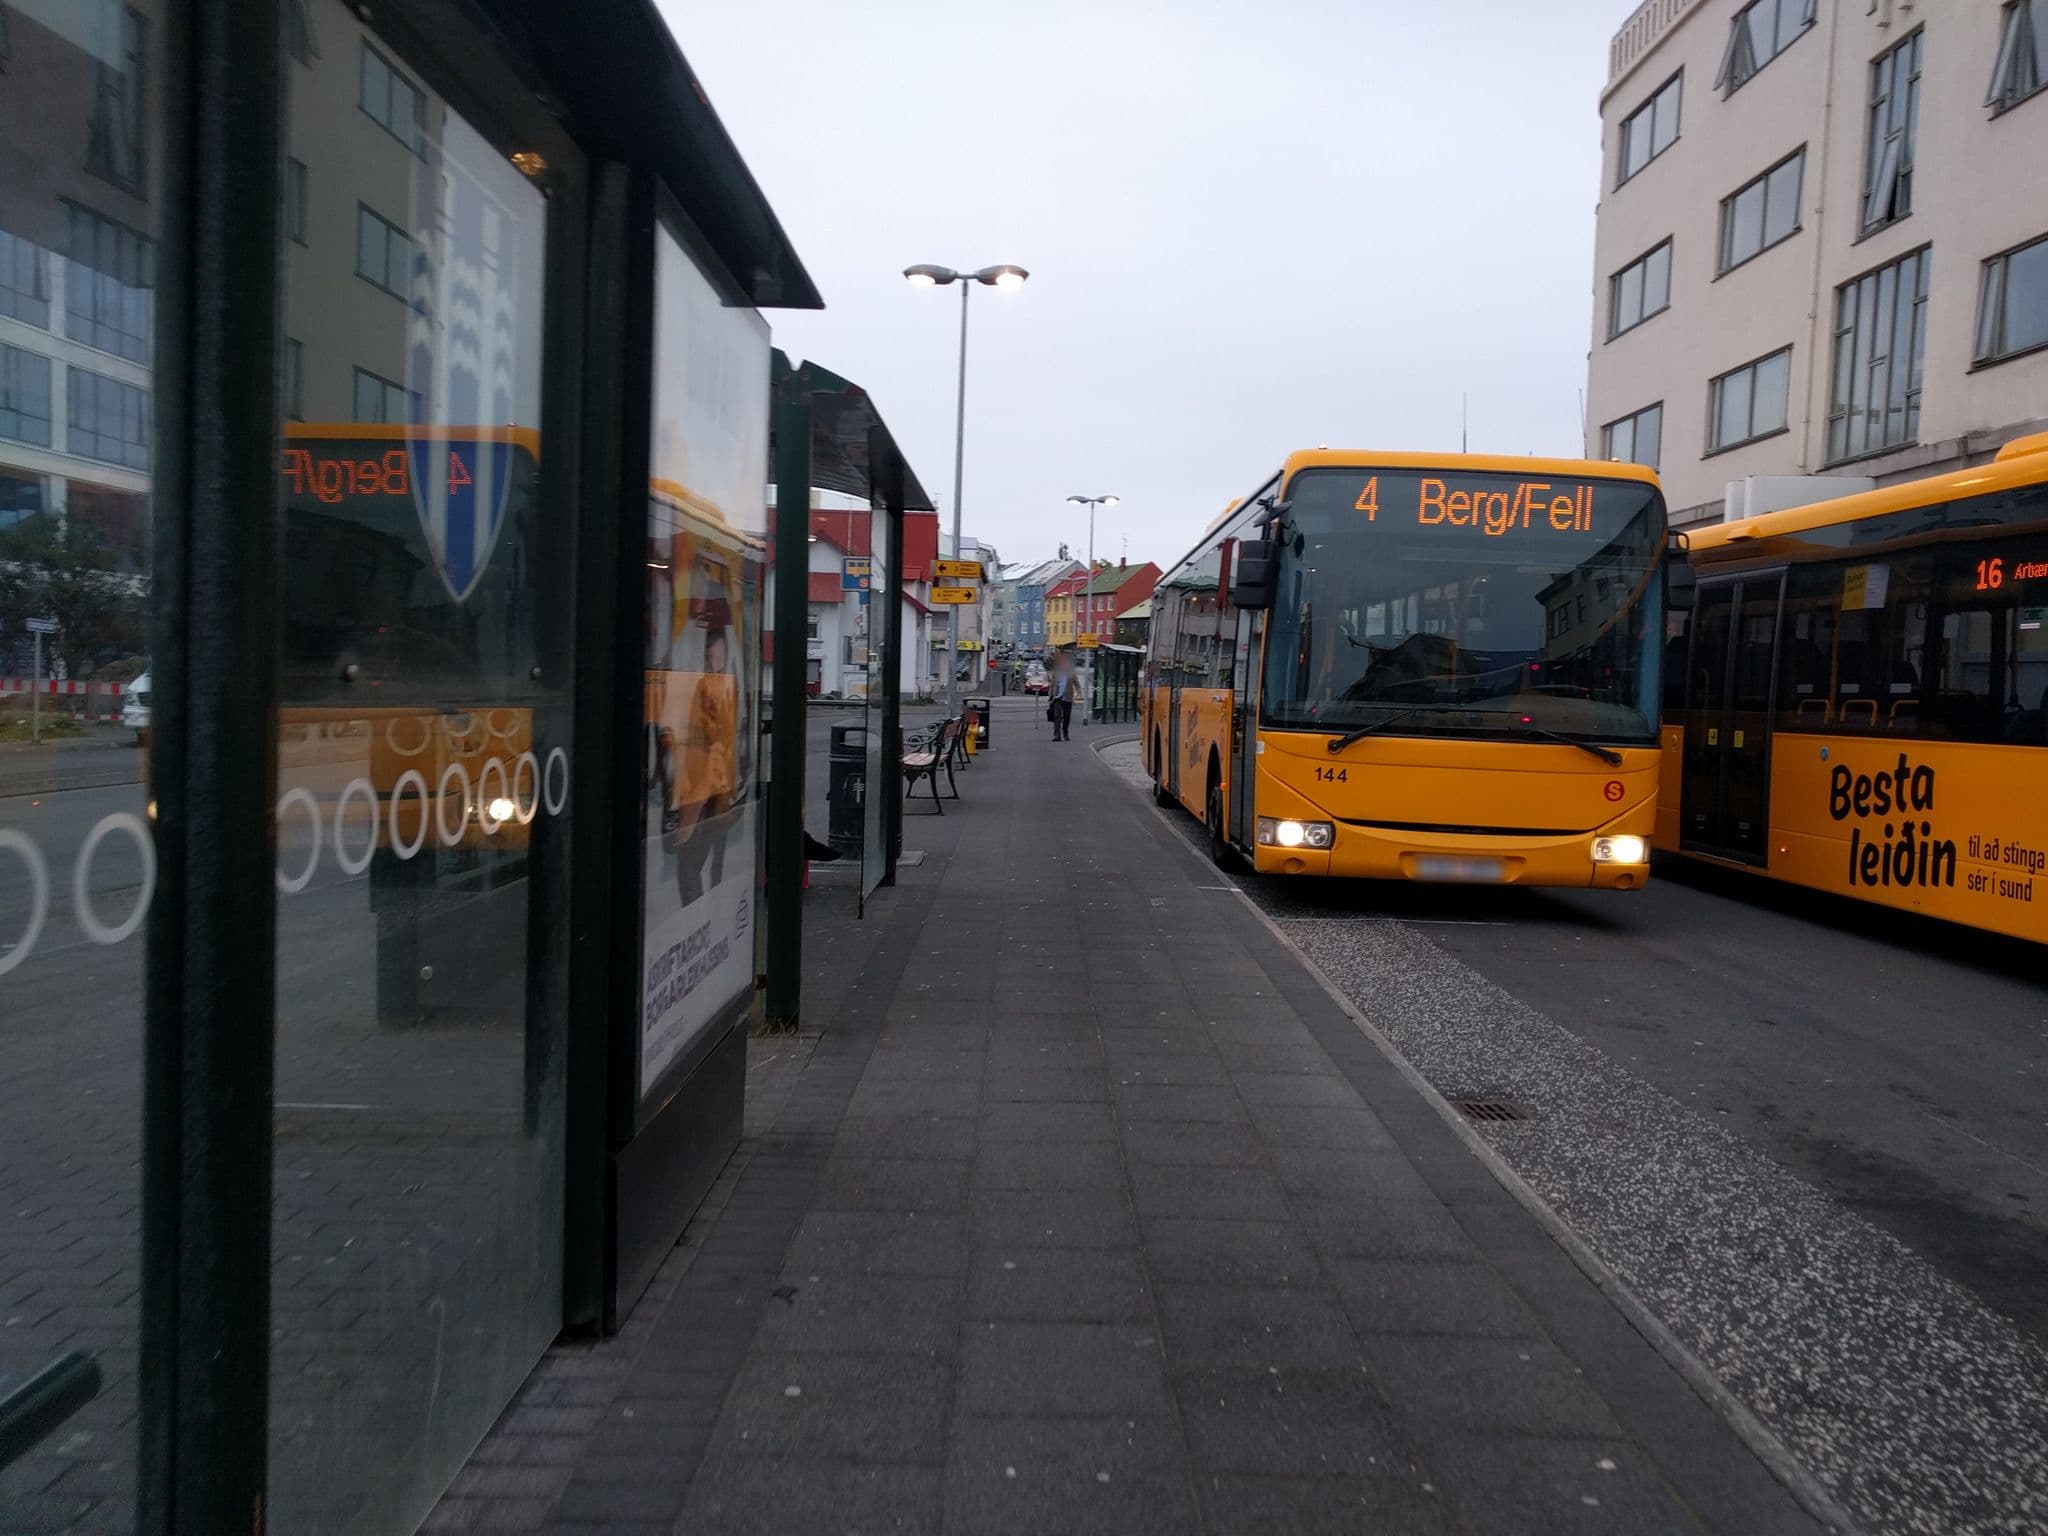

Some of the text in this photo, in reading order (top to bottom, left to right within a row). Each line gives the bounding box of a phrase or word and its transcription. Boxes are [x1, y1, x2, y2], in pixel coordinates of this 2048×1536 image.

[1355, 476, 1593, 536] 4 Berg/Fell
[1976, 558, 2003, 590] 16
[1314, 767, 1348, 784] 144
[1830, 753, 1935, 821] Besta
[1848, 820, 1956, 888] leiðin
[1968, 834, 2045, 874] til að stinga
[1967, 869, 2032, 903] sér í sund
